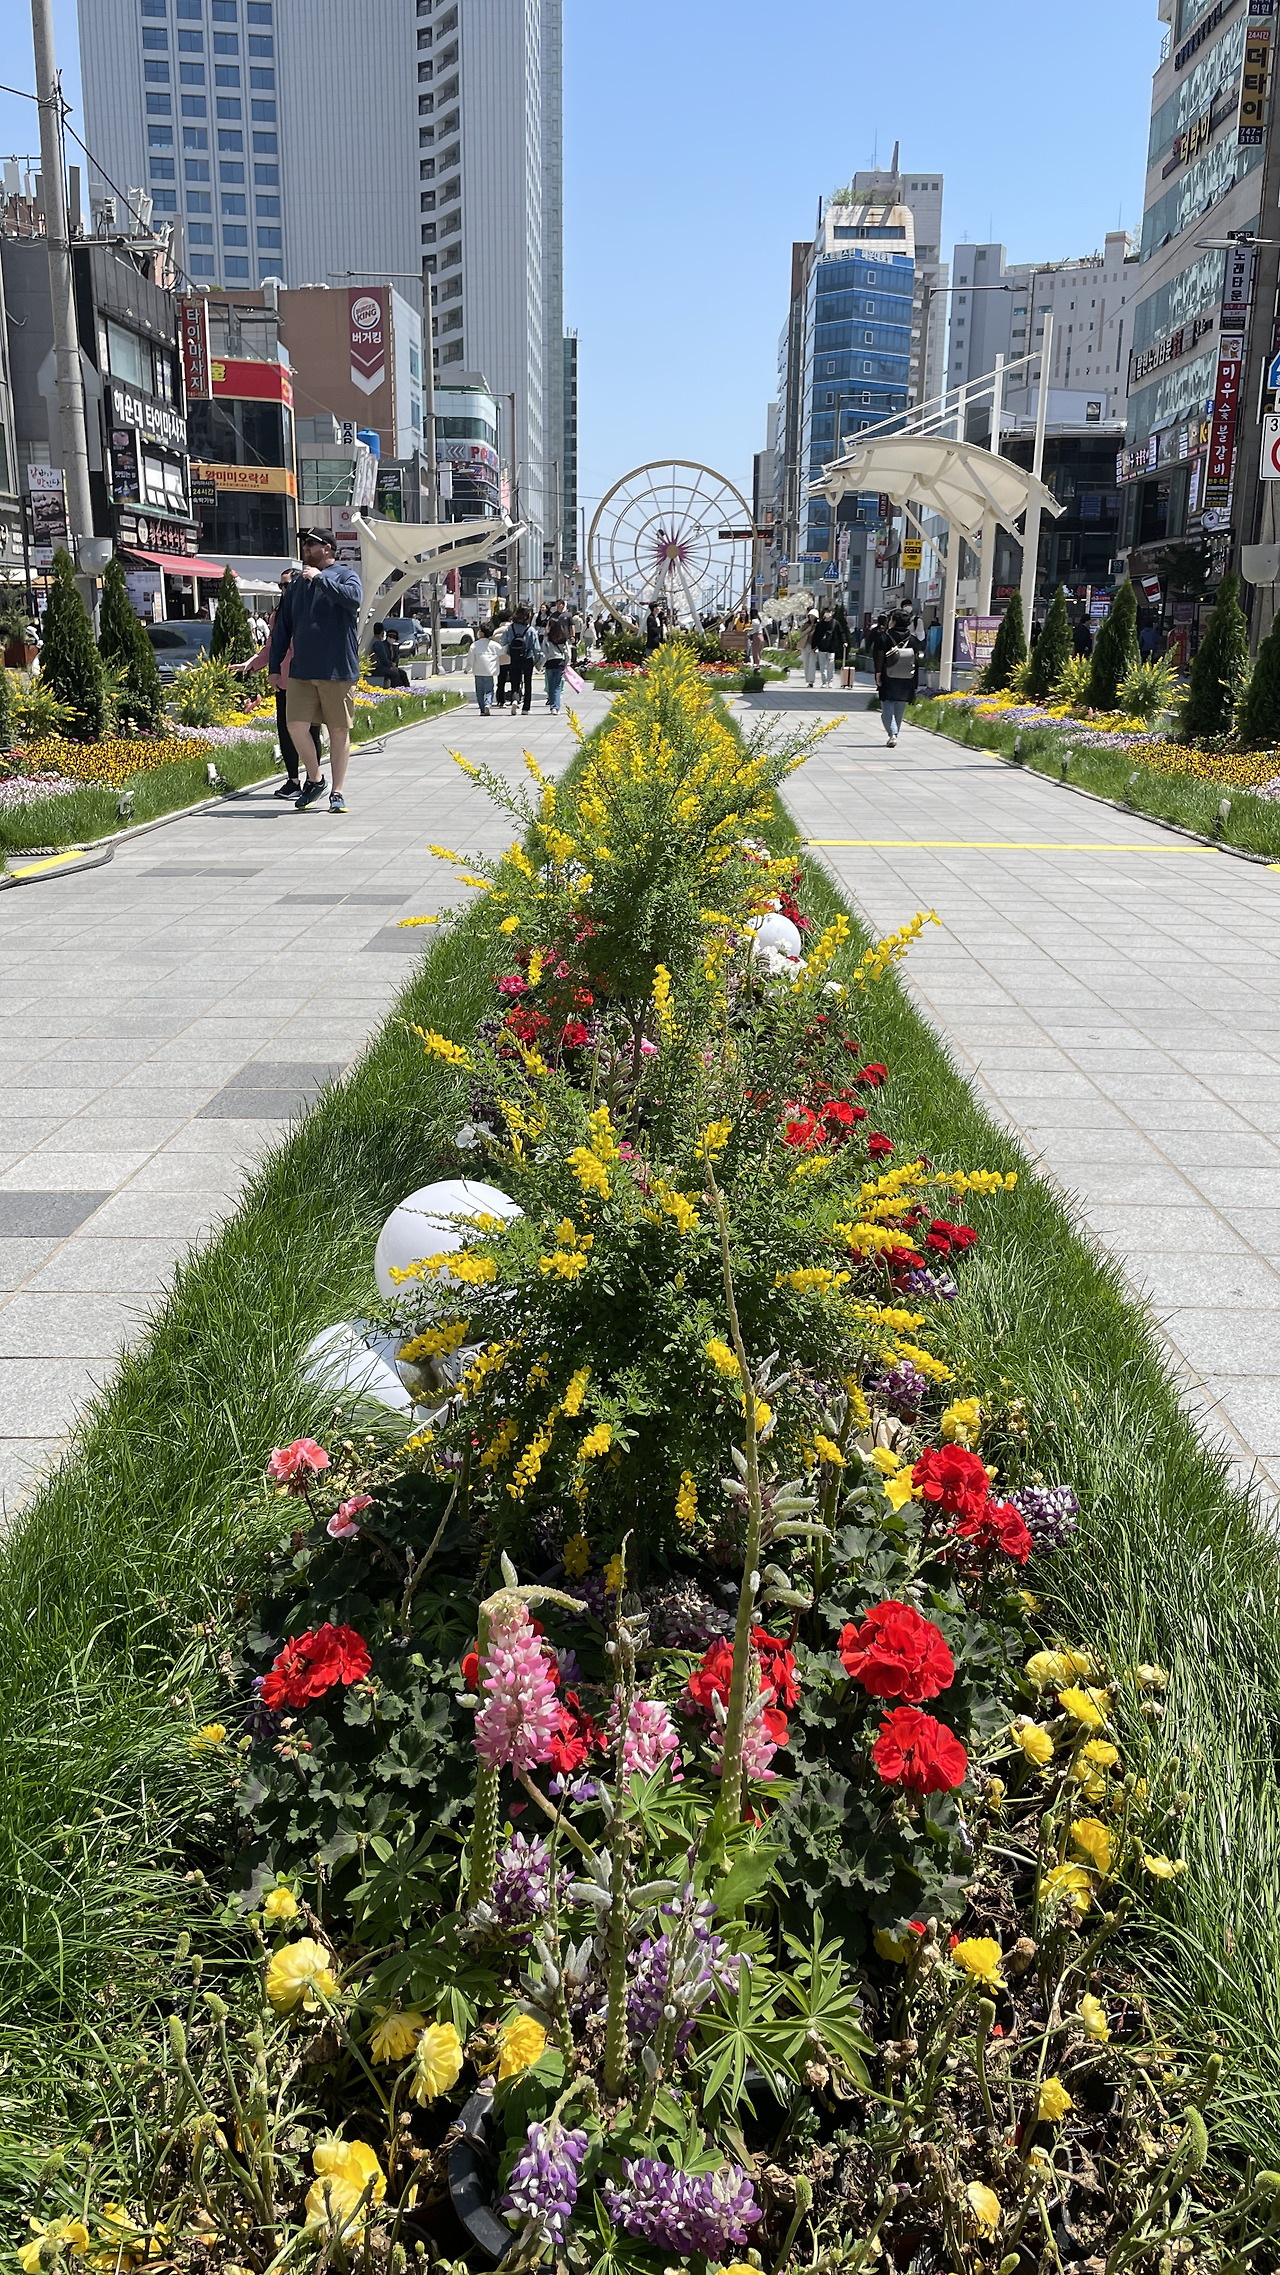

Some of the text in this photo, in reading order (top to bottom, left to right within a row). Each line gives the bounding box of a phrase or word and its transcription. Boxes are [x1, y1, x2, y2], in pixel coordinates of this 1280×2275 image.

[1252, 4, 1270, 14] 의원
[1247, 31, 1270, 40] 24시간
[1243, 47, 1267, 120] 더타이
[1231, 250, 1245, 302] 노래타운
[356, 308, 377, 322] KING
[352, 331, 382, 344] 버거킹
[186, 309, 203, 392] 타이마사지
[113, 389, 188, 446] 해운대 타이마사지
[205, 470, 269, 485] 왕미미오락실
